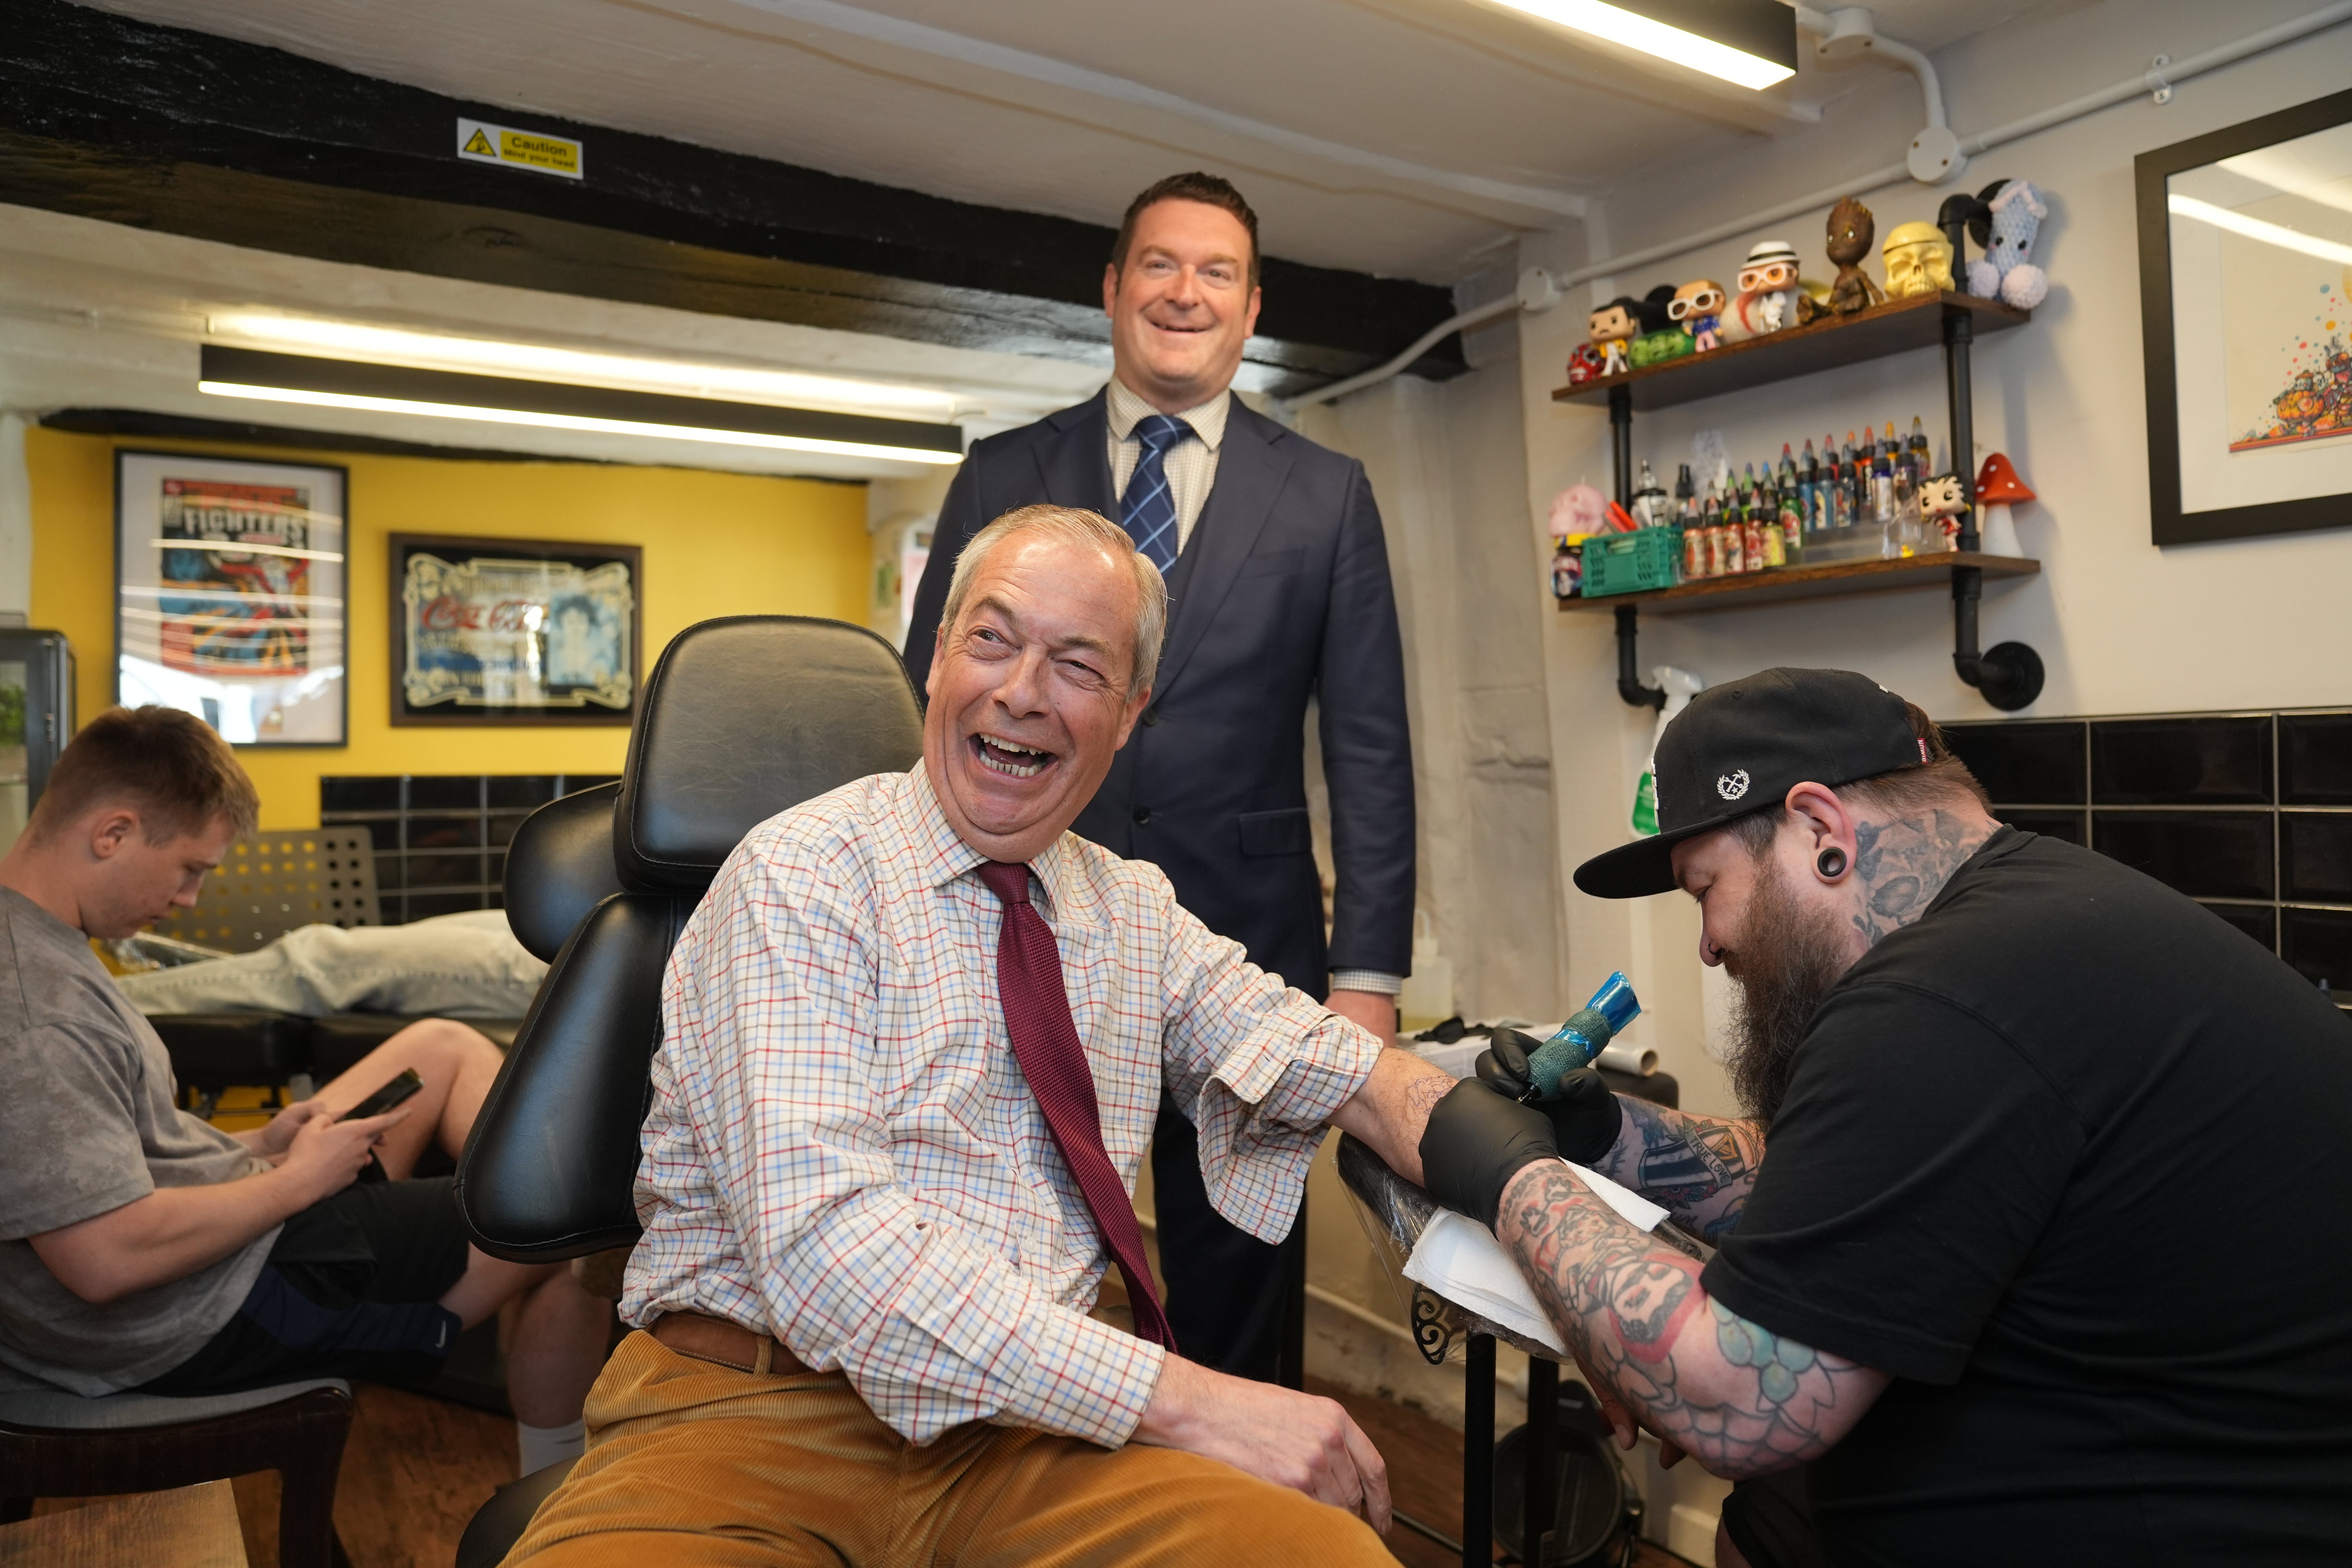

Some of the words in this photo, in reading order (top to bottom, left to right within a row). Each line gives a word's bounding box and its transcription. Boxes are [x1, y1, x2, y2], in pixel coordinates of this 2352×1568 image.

[504, 148, 526, 159] Mind
[530, 154, 549, 163] your
[511, 136, 567, 157] Caution
[1690, 1136, 1711, 1161] TRUE
[1710, 1158, 1730, 1183] LOVE
